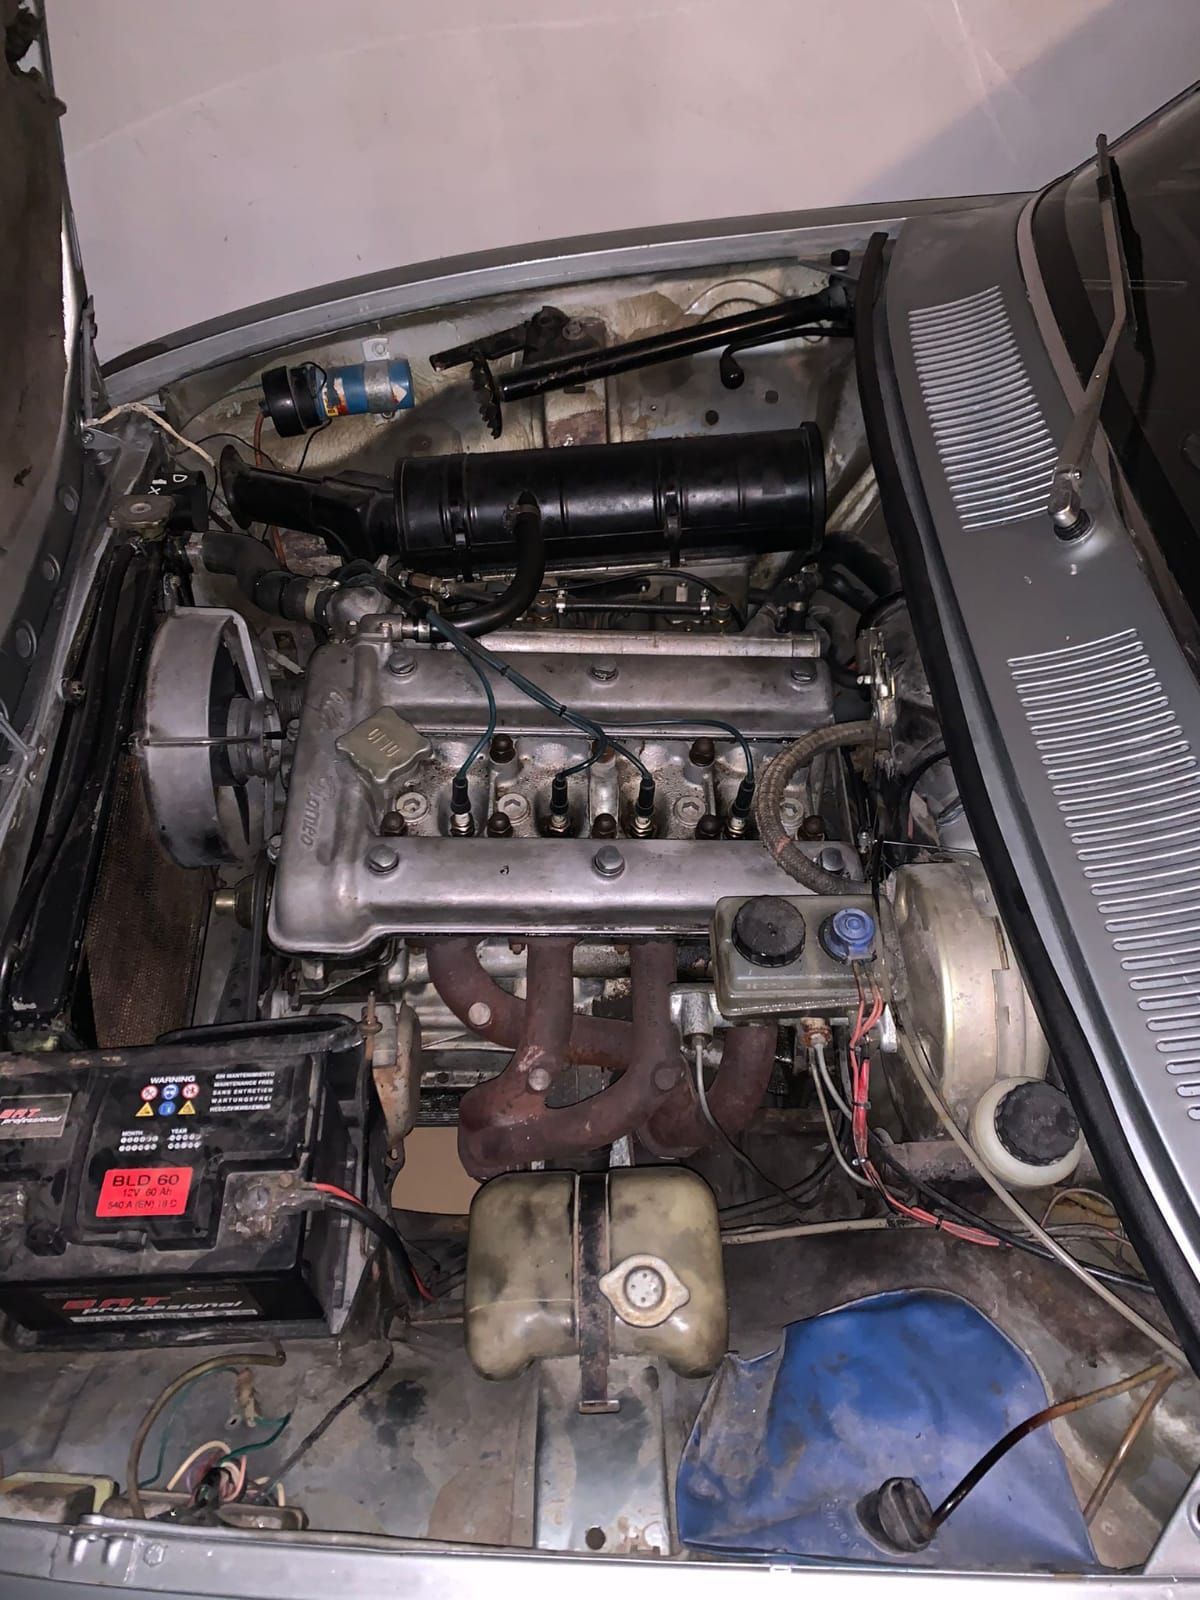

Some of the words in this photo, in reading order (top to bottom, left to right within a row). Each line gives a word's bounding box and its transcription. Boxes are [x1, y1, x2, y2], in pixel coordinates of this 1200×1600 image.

[149, 1074, 196, 1085] WARNING
[213, 1080, 257, 1088] MAINTENANCE
[233, 1087, 273, 1095] ENTRETIEN
[210, 1095, 273, 1104] WARTUNGSFREI
[170, 1127, 188, 1135] YEAR
[112, 1174, 151, 1187] BLD
[157, 1173, 180, 1186] 60
[82, 1299, 243, 1315] professional
